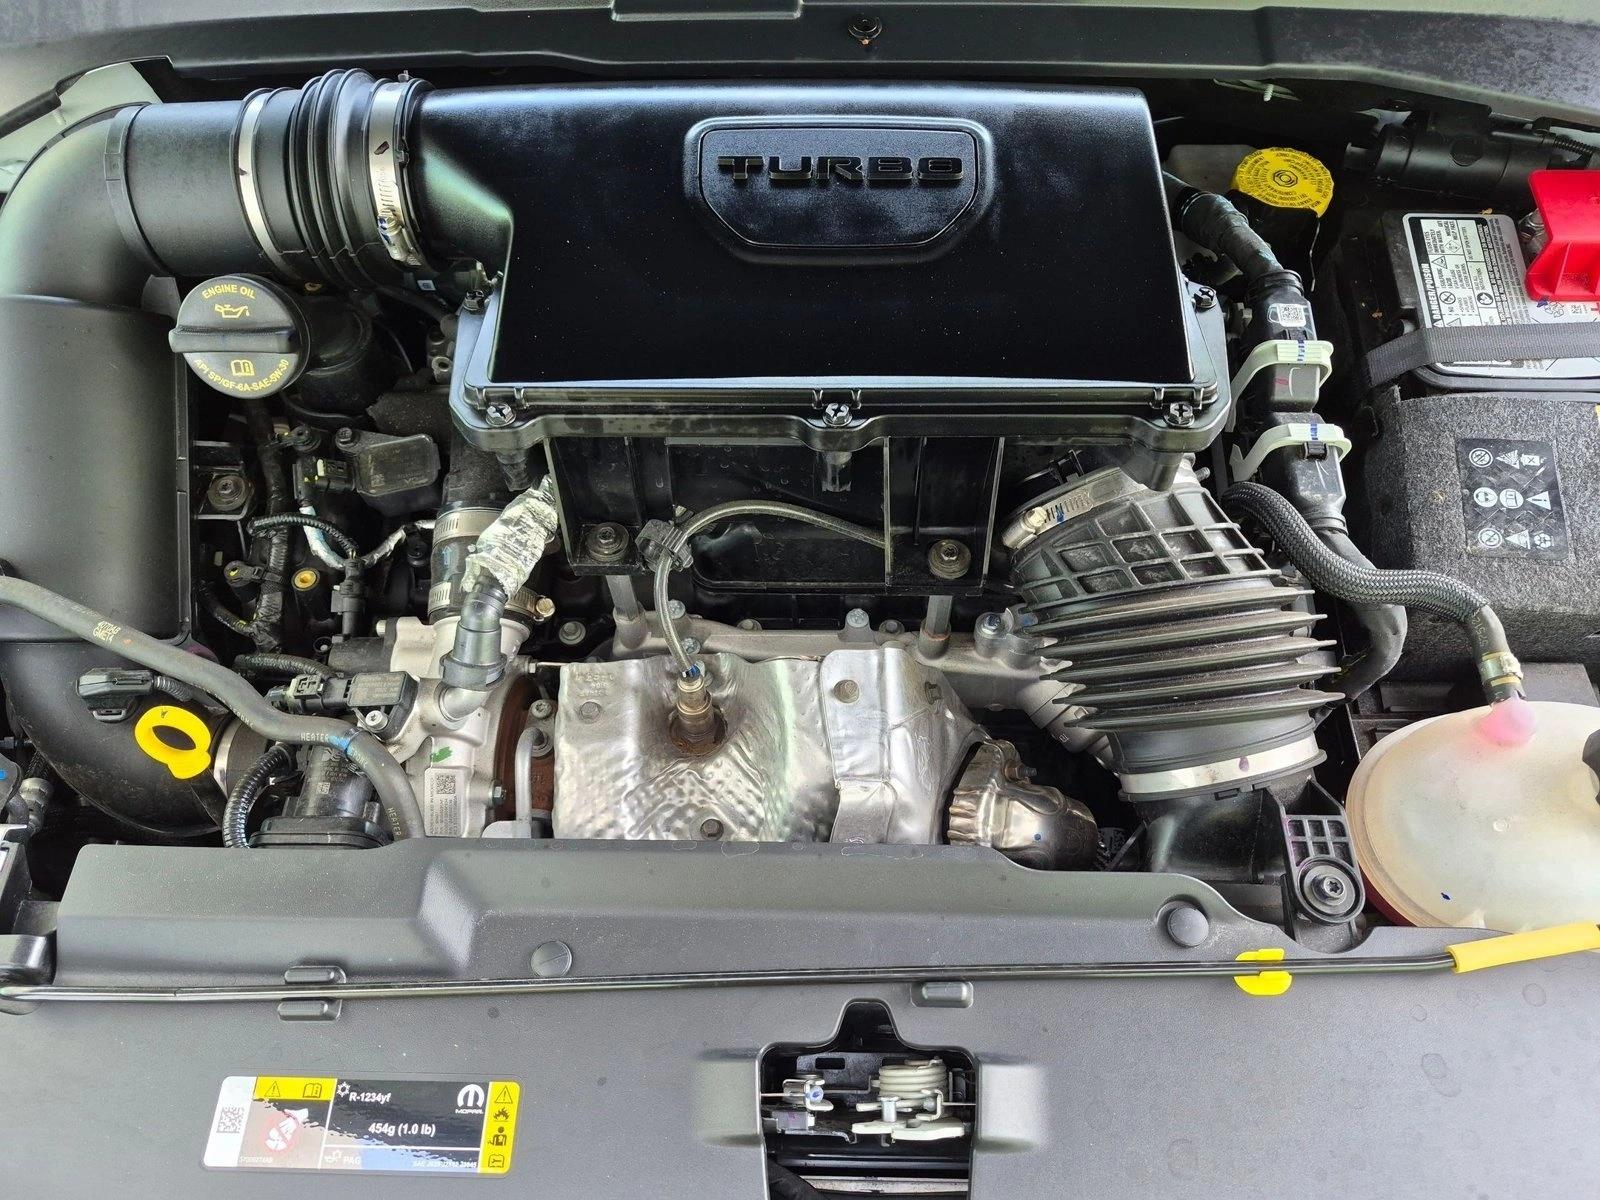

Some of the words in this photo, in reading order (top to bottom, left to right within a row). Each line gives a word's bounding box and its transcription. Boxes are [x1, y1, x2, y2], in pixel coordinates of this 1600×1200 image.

[202, 284, 238, 300] ENGINE
[239, 286, 257, 300] OIL
[1420, 263, 1441, 319] DANGER/POISON
[387, 807, 402, 837] HEATER
[349, 1092, 392, 1105] R-1234yf
[455, 1108, 484, 1116] MOPAR
[368, 1122, 396, 1137] 454g
[397, 1123, 419, 1137] (1.0
[421, 1123, 436, 1138] lb)
